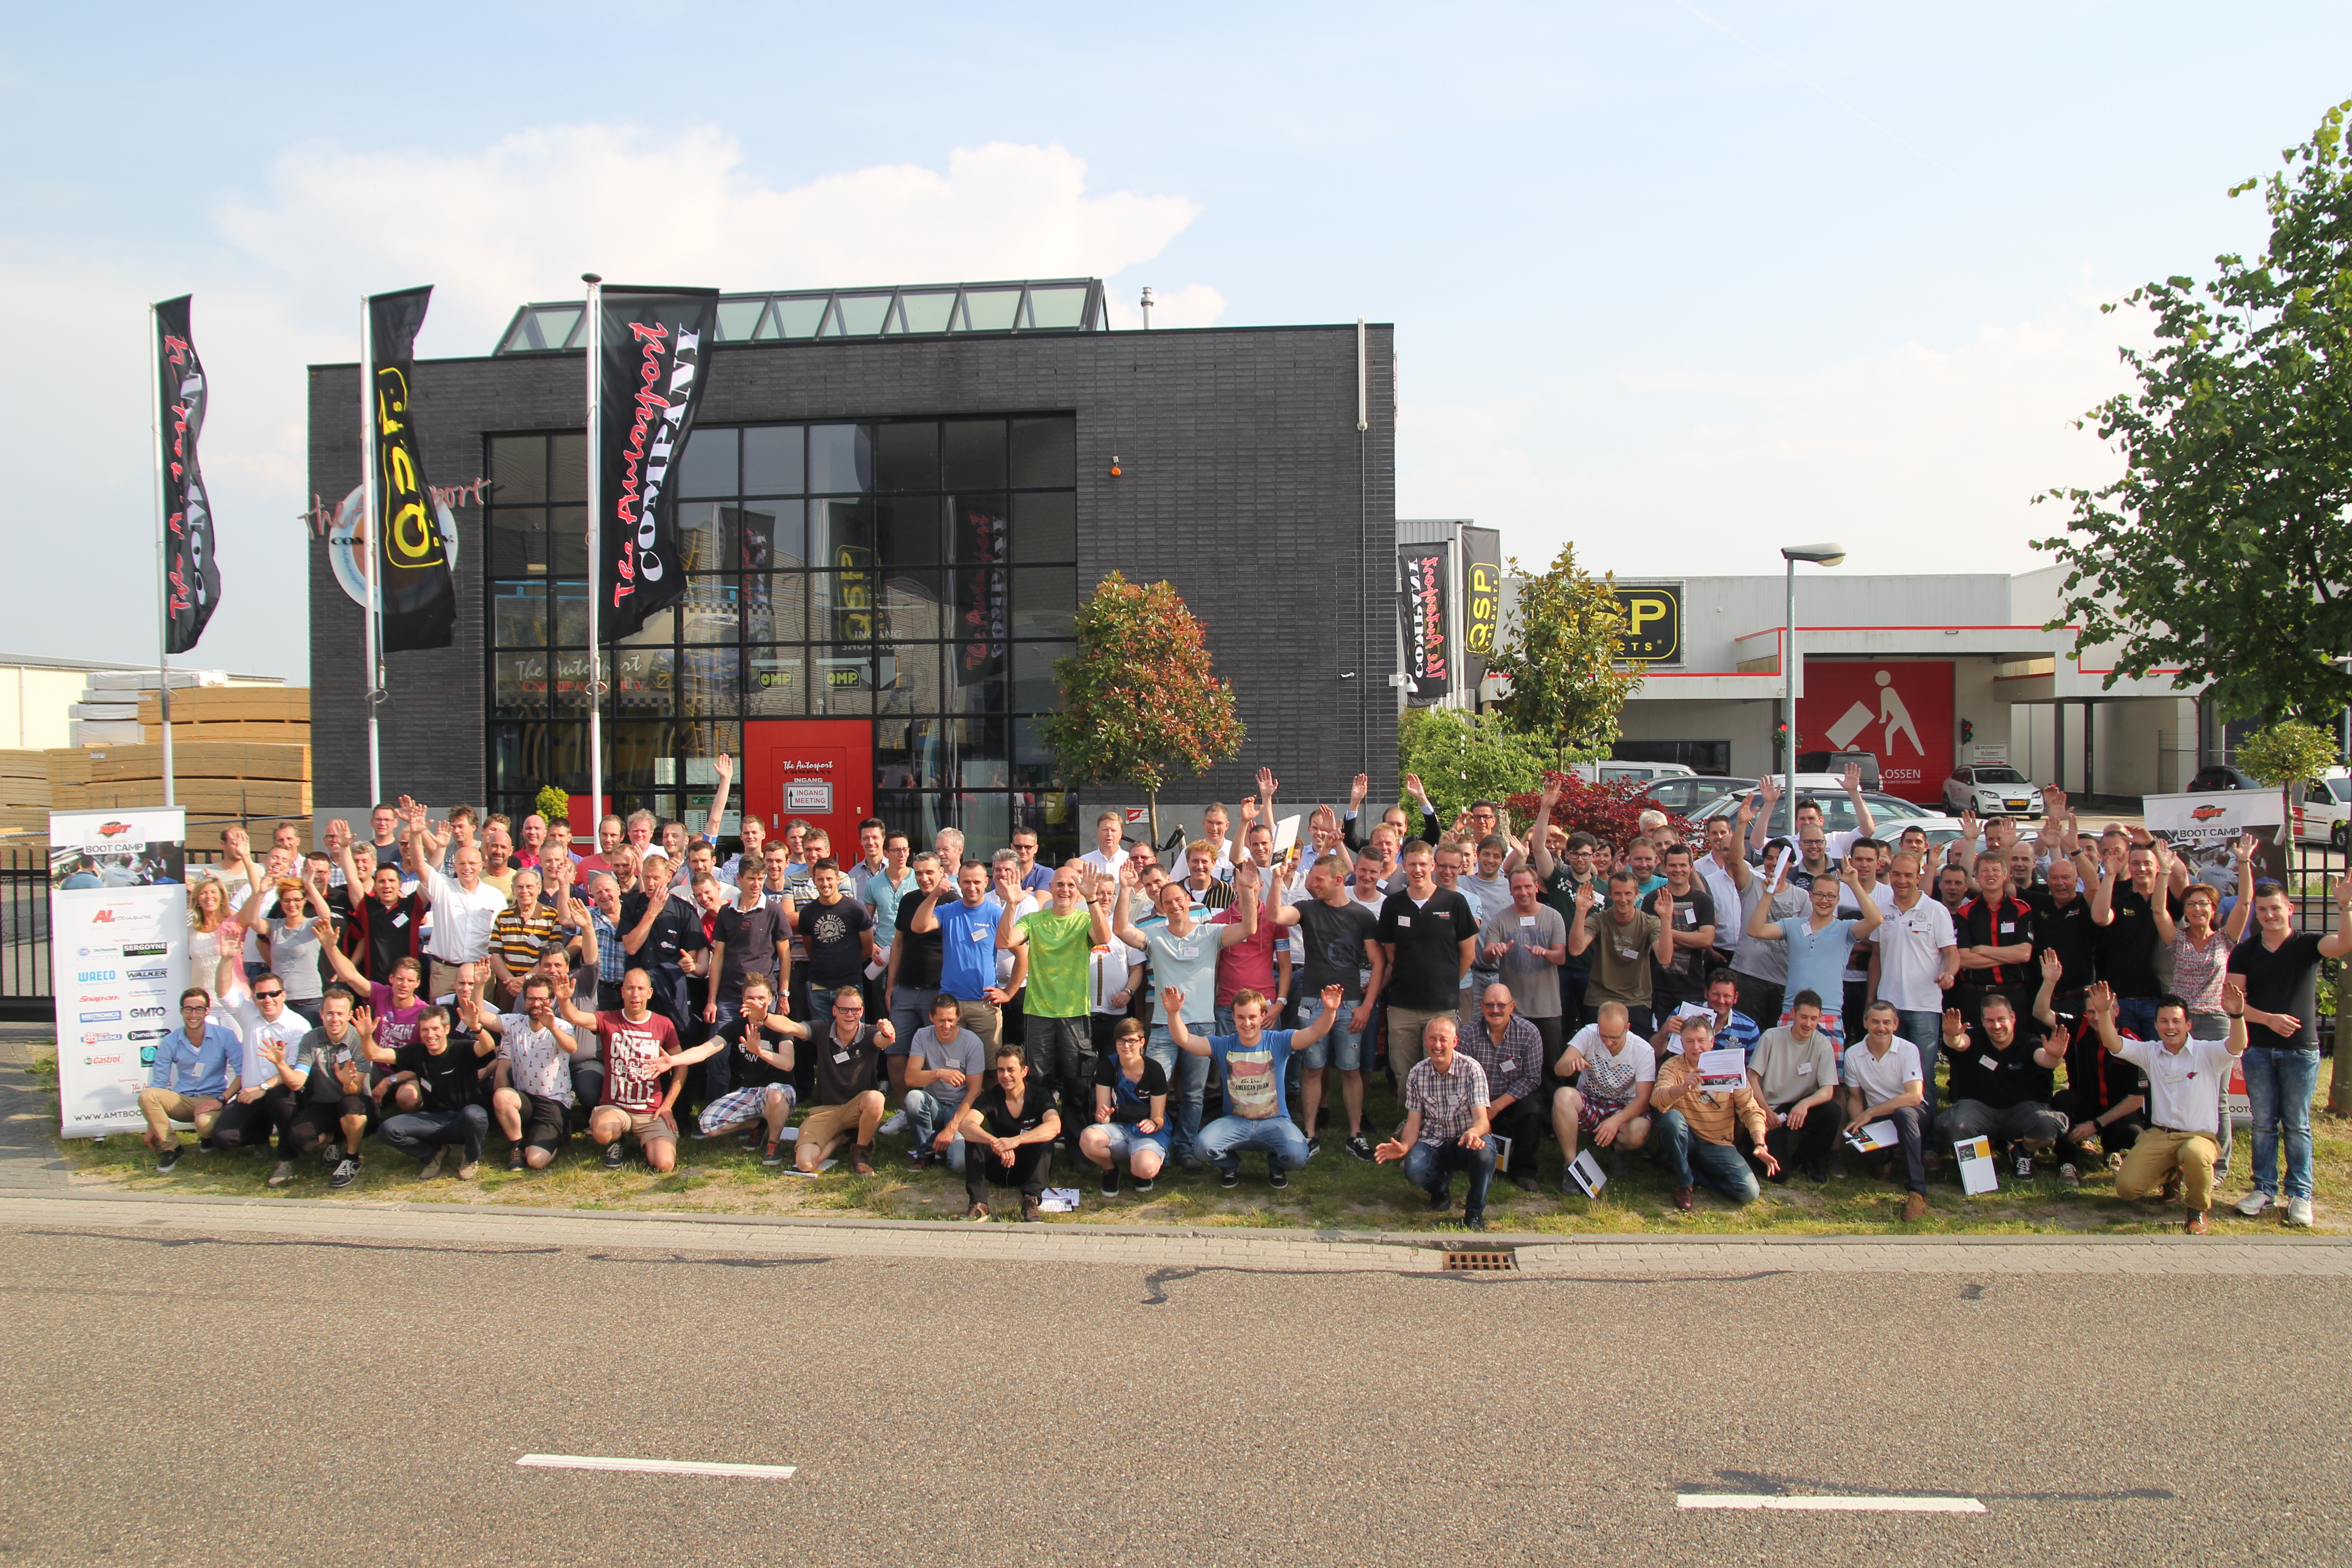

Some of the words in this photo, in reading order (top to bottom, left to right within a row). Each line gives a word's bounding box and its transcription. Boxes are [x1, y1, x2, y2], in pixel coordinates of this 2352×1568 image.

[637, 322, 701, 582] COMPANY
[614, 538, 636, 608] The
[1469, 569, 1492, 648] QSP
[1485, 579, 1499, 647] PRODUCTS
[515, 658, 544, 681] The
[760, 673, 792, 686] OMP
[826, 671, 858, 685] OMP
[783, 760, 794, 770] The
[796, 760, 833, 771] Autosport
[2190, 808, 2227, 818] AMT
[2180, 829, 2207, 838] BOOT
[2210, 828, 2239, 836] CAMP
[85, 844, 113, 853] BOOT
[114, 843, 143, 852] CAMP
[814, 916, 825, 935] TOMMY
[827, 914, 846, 933] HILFIGER
[124, 942, 167, 951] SERGOYNE
[78, 970, 116, 982] WAECO
[130, 1006, 166, 1018] GMTO
[93, 1055, 121, 1064] Castrol
[610, 1073, 655, 1103] VILLE
[1256, 1082, 1269, 1090] DREAM
